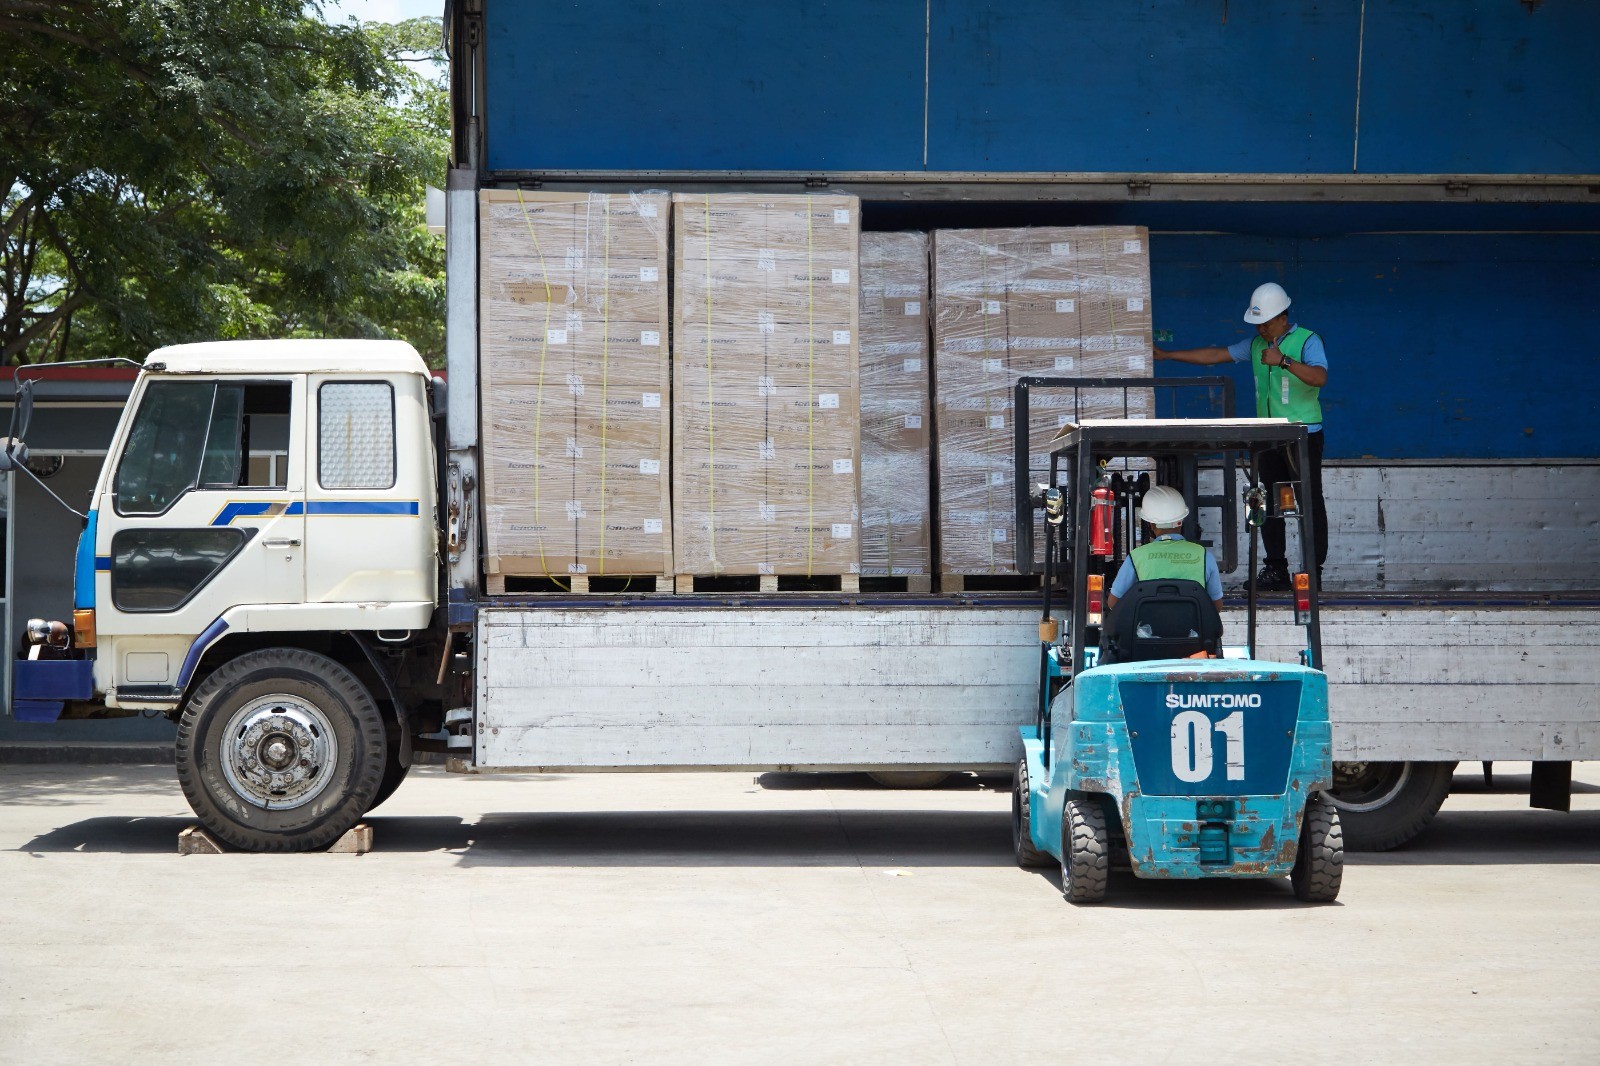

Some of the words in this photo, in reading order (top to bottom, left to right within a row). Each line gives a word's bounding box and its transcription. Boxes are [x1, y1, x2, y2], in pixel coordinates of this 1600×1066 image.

[1147, 551, 1192, 560] DIMERCO
[1165, 693, 1261, 708] SUMITOMO
[1170, 710, 1245, 783] 01
